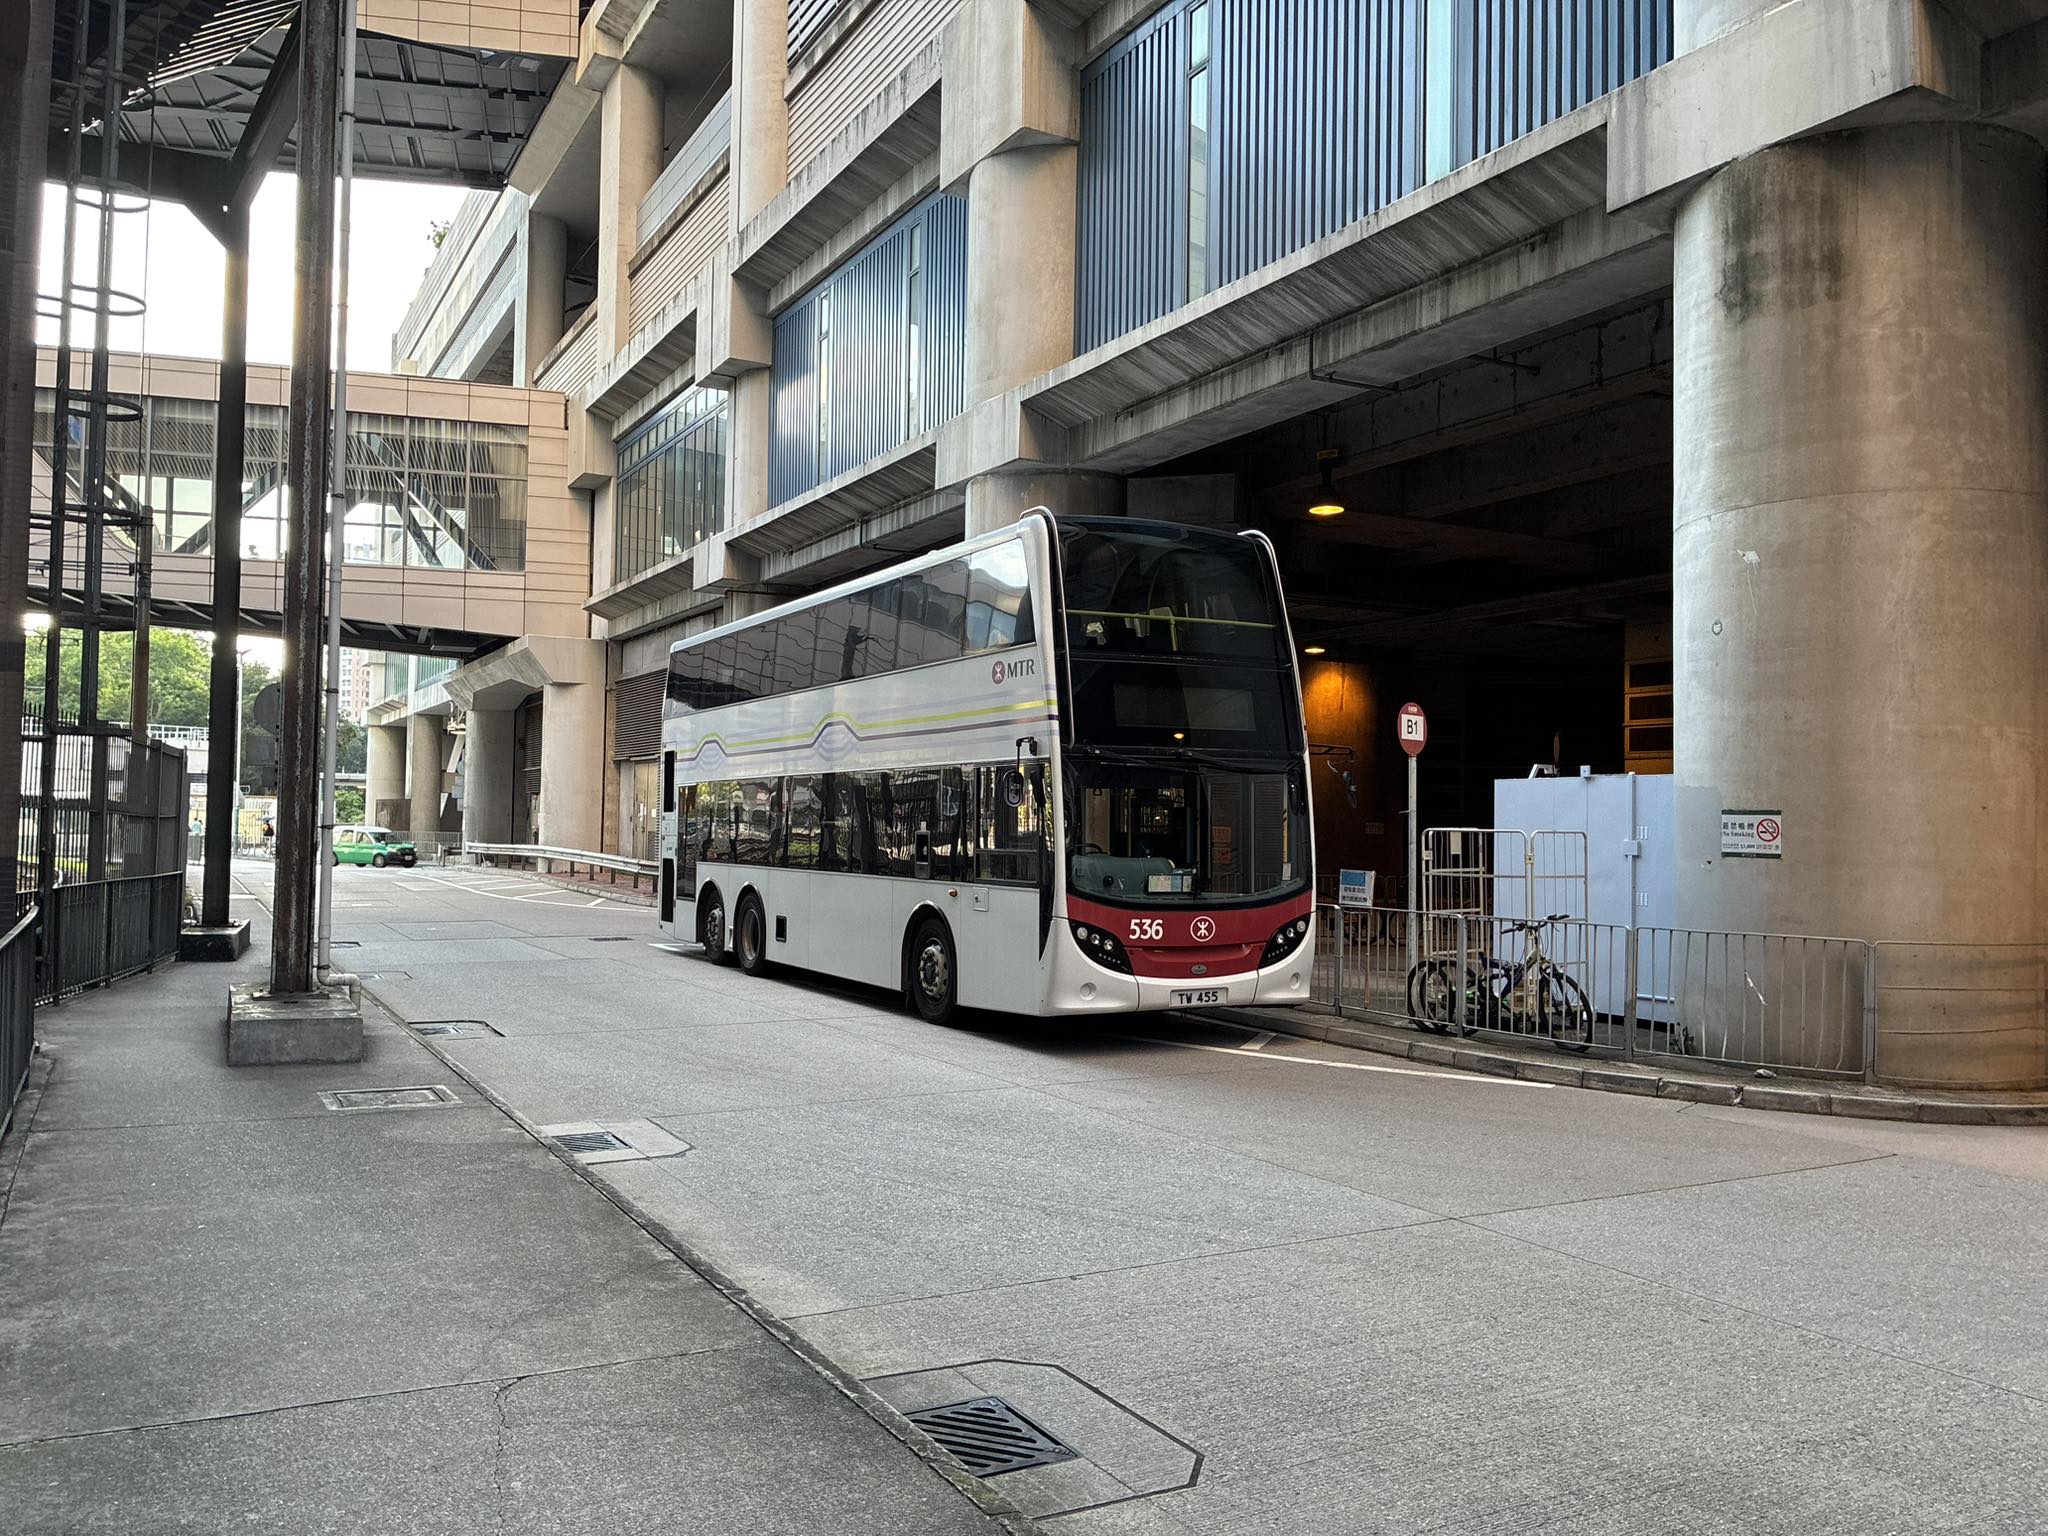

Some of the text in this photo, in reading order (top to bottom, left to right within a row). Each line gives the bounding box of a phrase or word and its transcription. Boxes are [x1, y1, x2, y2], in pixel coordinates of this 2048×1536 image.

[1007, 658, 1035, 679] MTR
[1407, 719, 1418, 735] B1
[1129, 919, 1163, 939] 536
[1178, 991, 1219, 1004] TW 455
